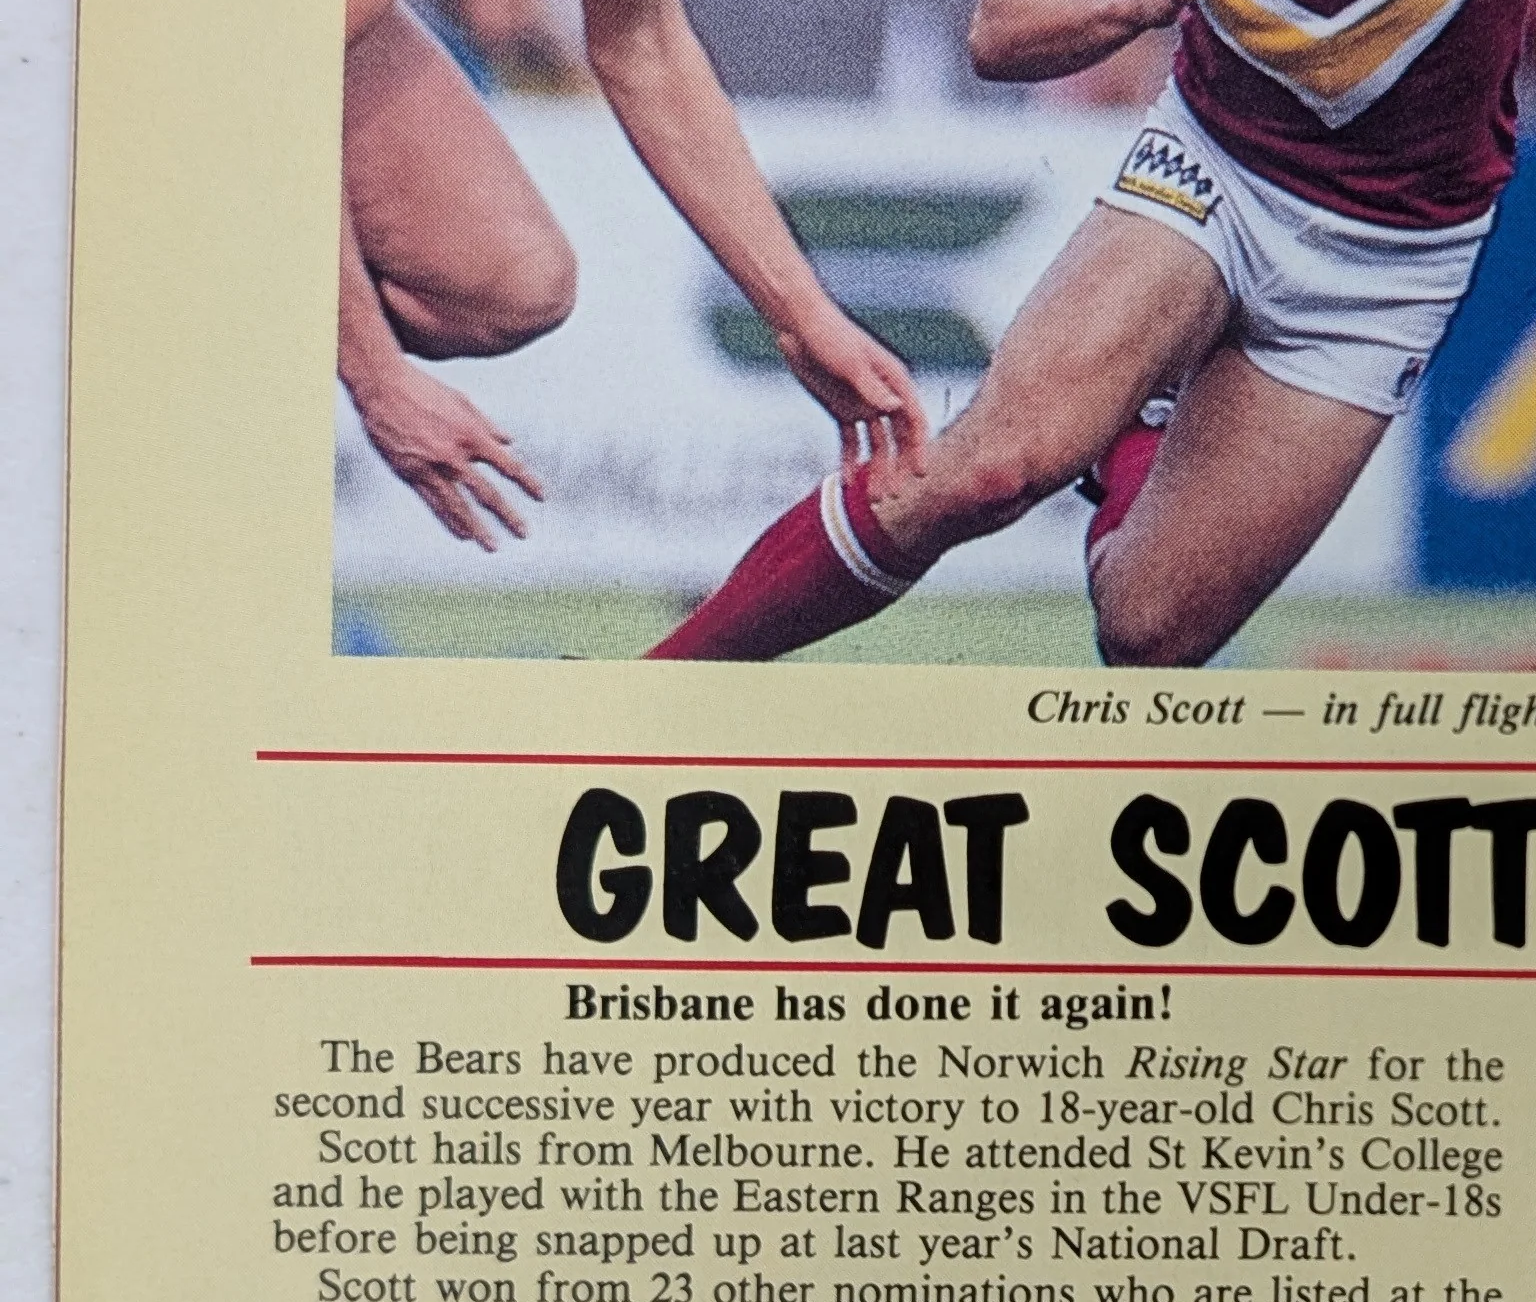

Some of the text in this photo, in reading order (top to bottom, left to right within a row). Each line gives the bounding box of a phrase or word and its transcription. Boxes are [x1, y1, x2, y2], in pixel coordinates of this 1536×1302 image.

[1027, 690, 1131, 725] Chris
[1145, 691, 1246, 725] Scott
[1322, 692, 1359, 726] in
[1369, 691, 1445, 734] full
[556, 787, 1030, 950] GREAT
[564, 983, 1172, 1031] Brisbane has done it again!
[320, 1039, 1505, 1088] The Bears have produced the Norwich Rising Star for the
[272, 1173, 1502, 1222] and he played with the Eastern Ranges in the VSFL Under-18s
